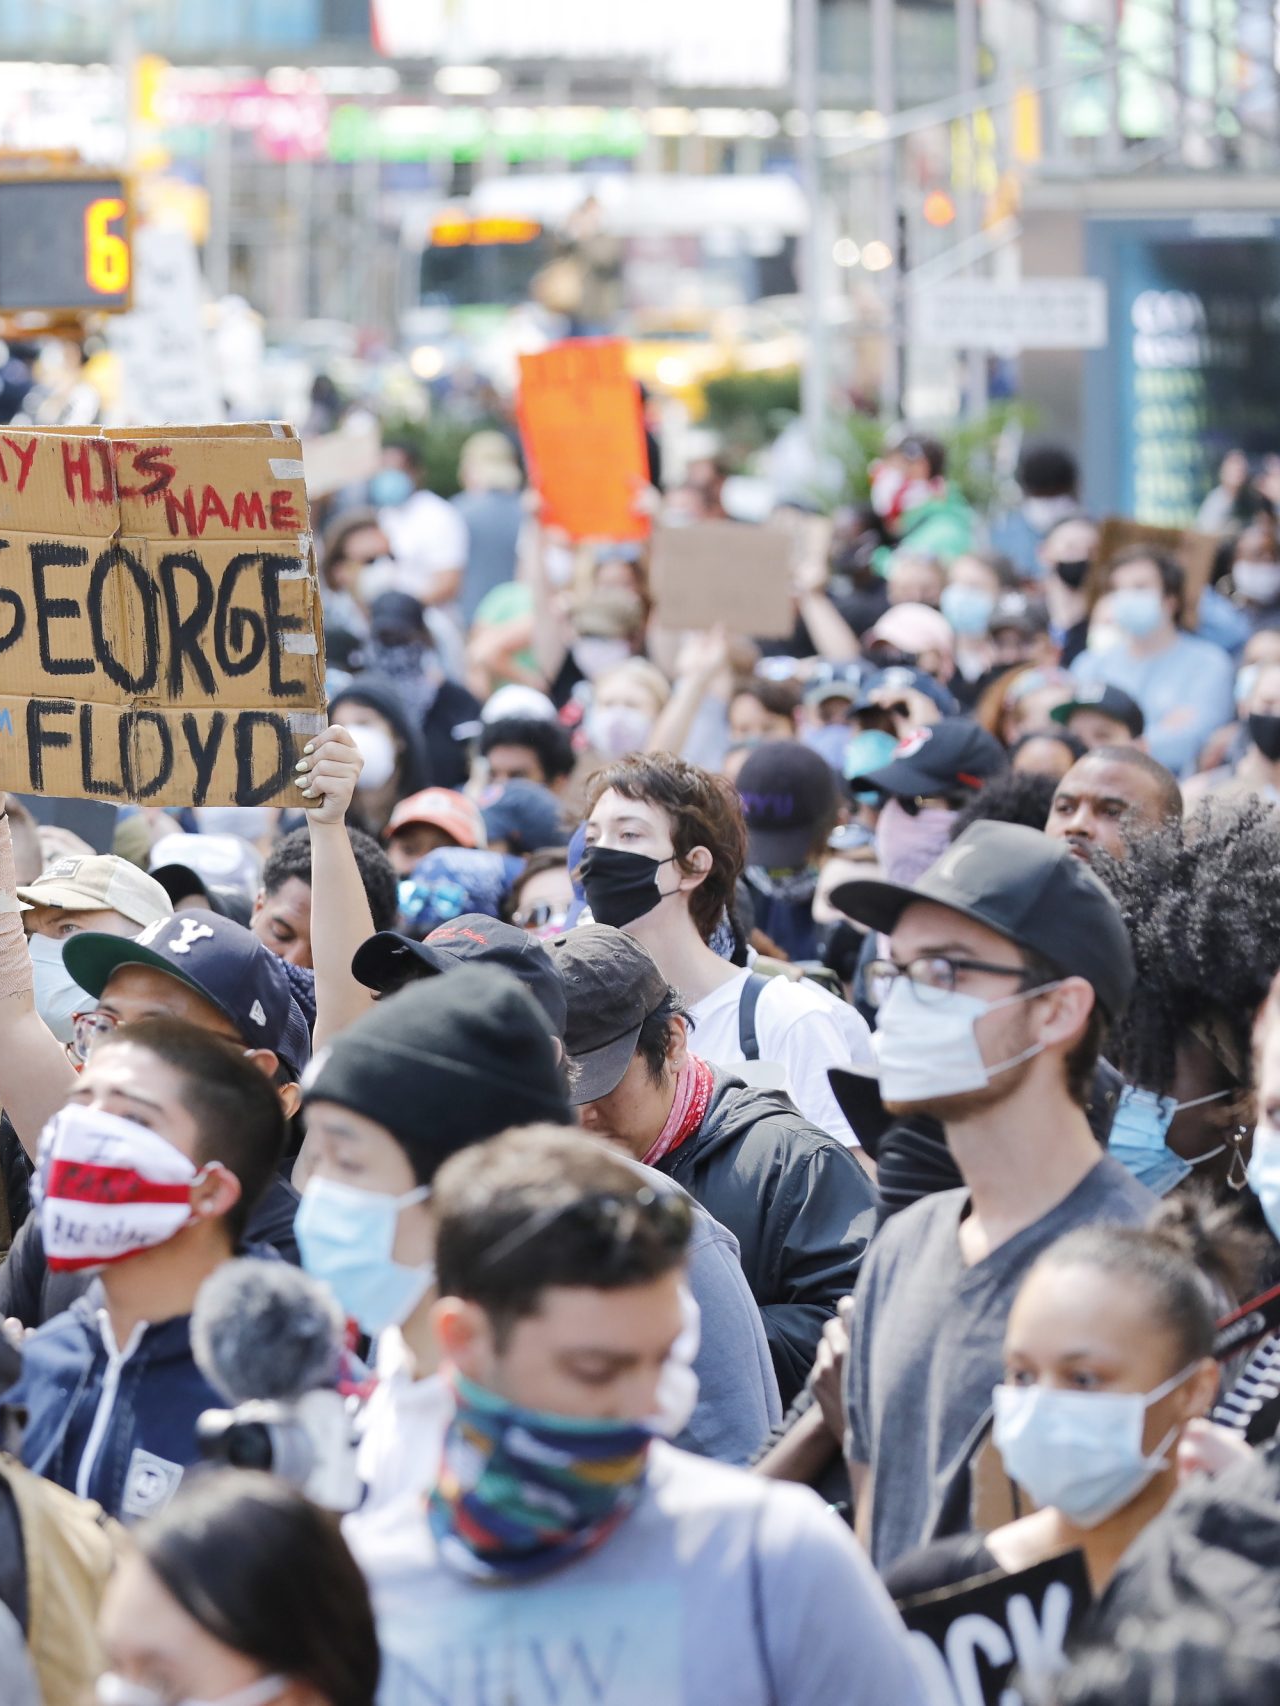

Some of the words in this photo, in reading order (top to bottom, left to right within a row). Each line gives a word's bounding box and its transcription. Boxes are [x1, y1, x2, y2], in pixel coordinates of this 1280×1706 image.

[84, 198, 131, 294] 6
[61, 440, 177, 508] HIS
[163, 485, 301, 538] NAME
[27, 699, 297, 808] FLOYD
